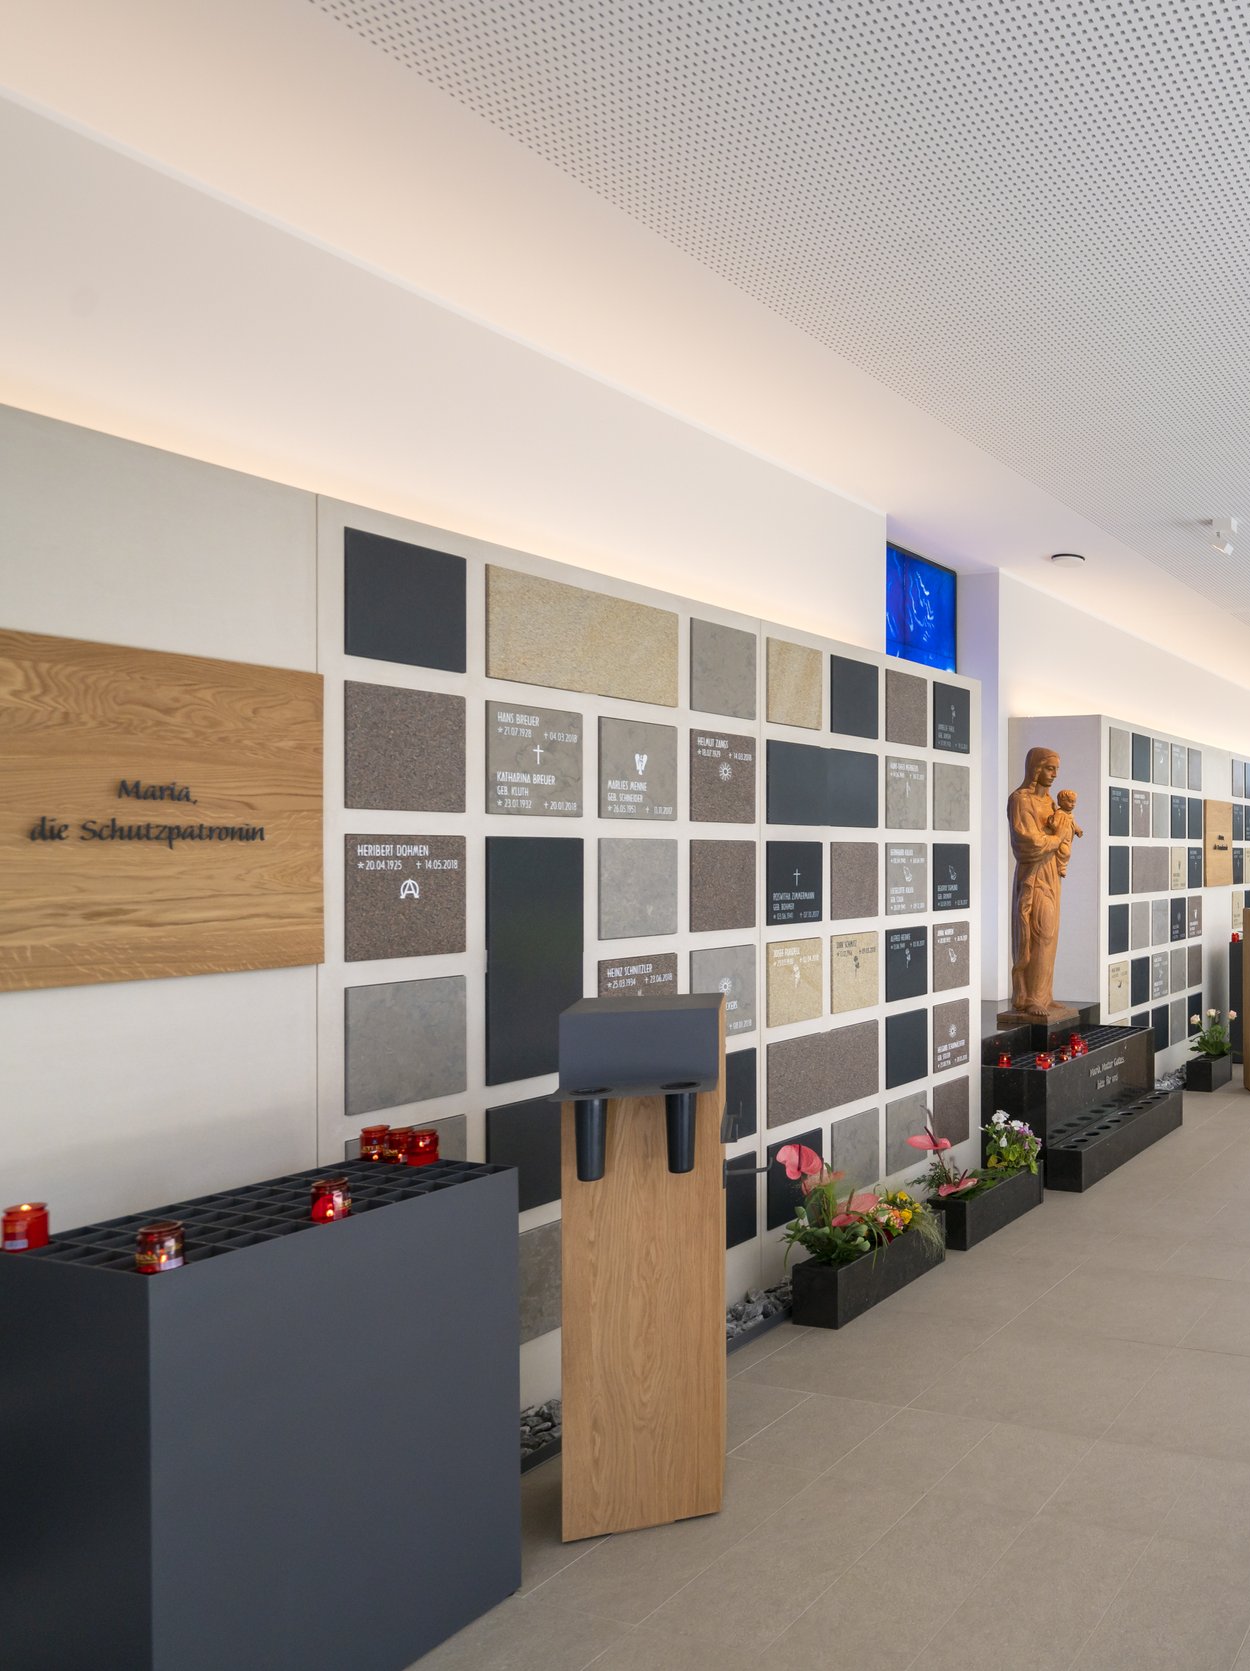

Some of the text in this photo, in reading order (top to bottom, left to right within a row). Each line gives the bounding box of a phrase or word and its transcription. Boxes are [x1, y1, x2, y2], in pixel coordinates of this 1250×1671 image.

[497, 711, 540, 727] HANS BREUER
[497, 771, 556, 785] KATHARINA BREUER
[117, 778, 198, 805] Maria,
[30, 815, 265, 850] die Schutzpatronin
[357, 844, 429, 857] HERIBERT DOHMEN
[366, 860, 458, 870] 20.04.1925 14.05.2018
[607, 963, 653, 978] HEINZ SCHNITZLER
